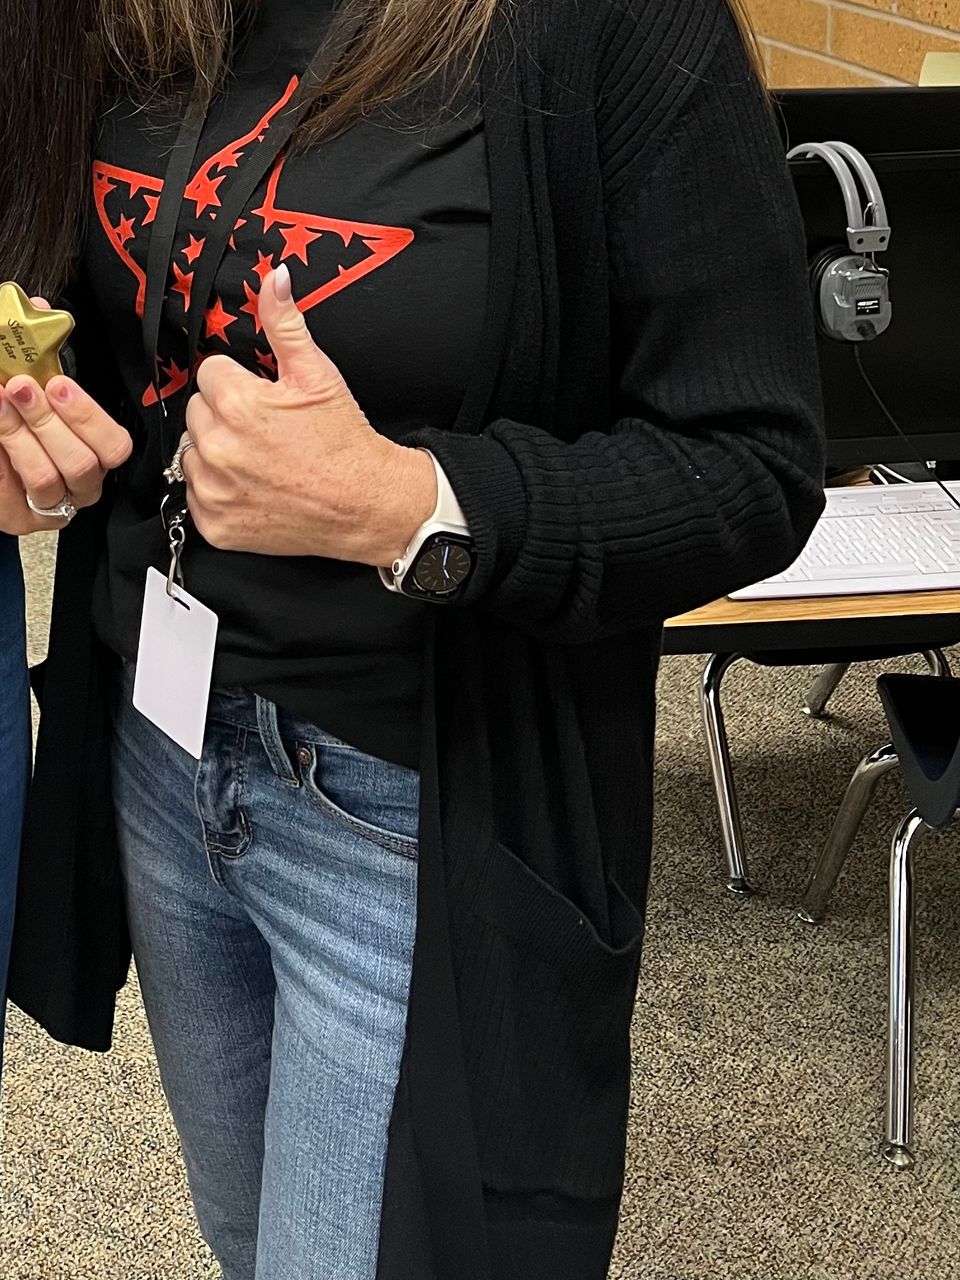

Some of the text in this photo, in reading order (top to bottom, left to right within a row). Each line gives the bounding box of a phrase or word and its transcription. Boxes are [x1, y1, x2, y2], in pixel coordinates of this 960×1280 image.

[2, 342, 17, 360] star
[7, 318, 39, 363] Shine like
